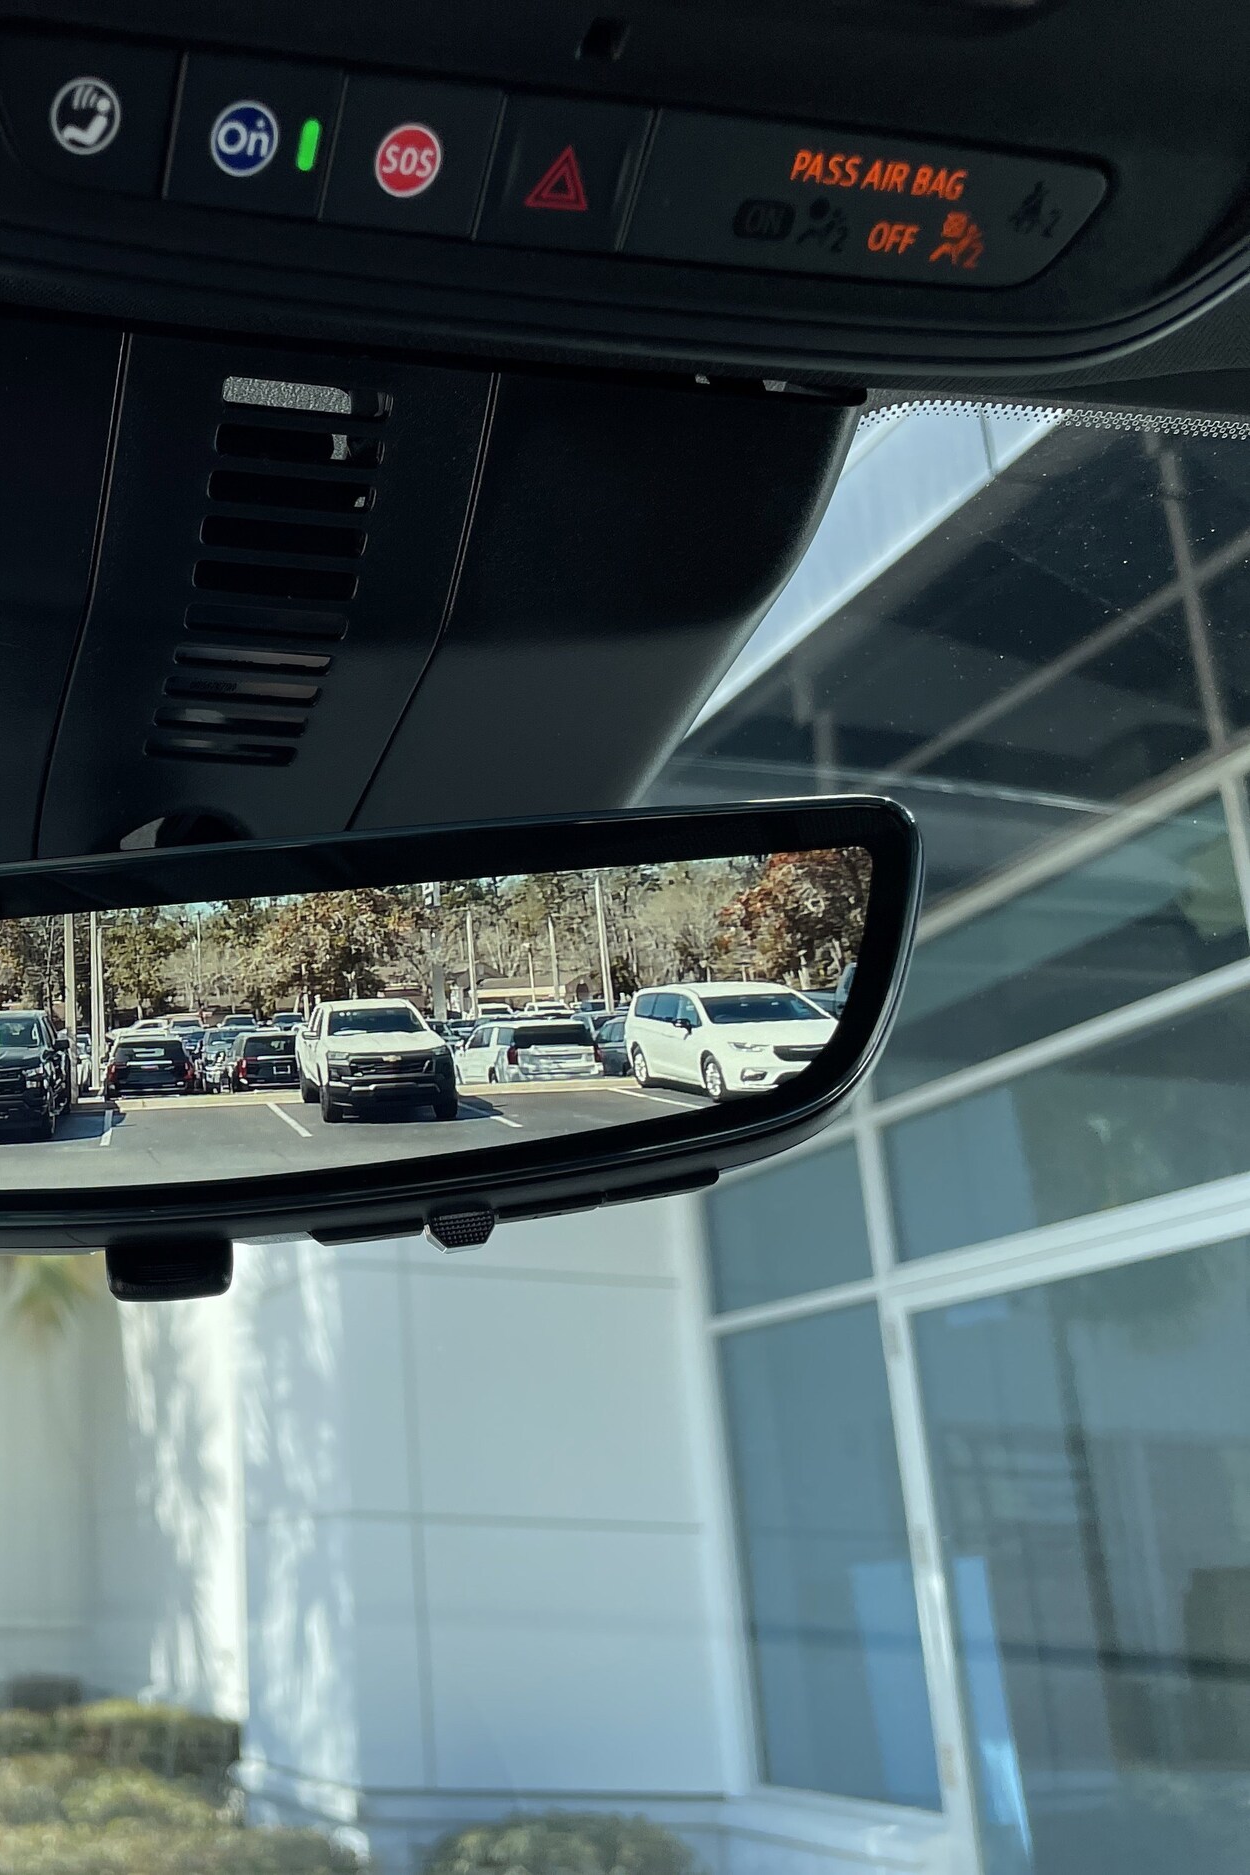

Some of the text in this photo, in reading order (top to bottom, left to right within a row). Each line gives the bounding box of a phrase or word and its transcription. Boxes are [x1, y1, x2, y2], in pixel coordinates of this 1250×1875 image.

[217, 119, 269, 157] On
[381, 144, 436, 178] SOS
[790, 149, 968, 200] PASS AIR BAG
[867, 221, 919, 254] OFF
